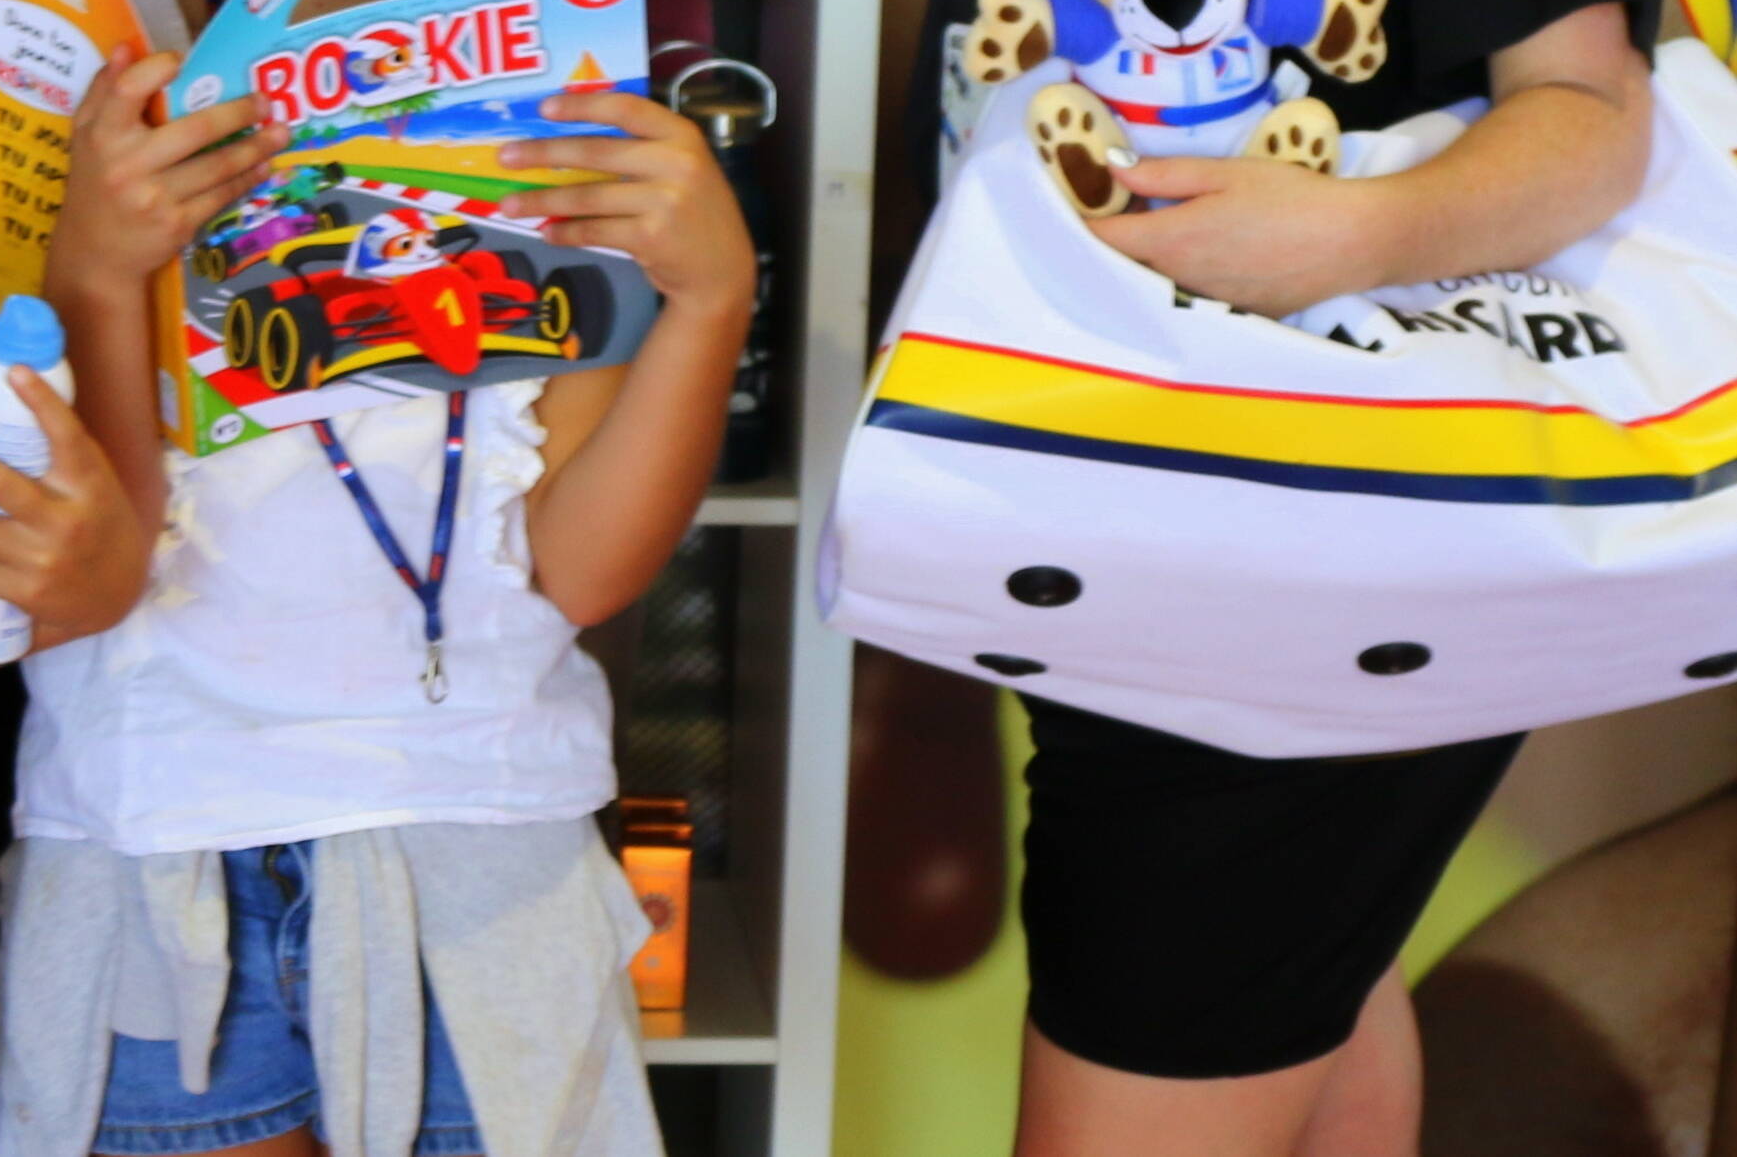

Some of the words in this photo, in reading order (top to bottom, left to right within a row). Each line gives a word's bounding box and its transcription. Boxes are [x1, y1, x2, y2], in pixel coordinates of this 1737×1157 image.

[0, 144, 28, 168] TU
[1, 180, 30, 205] TU
[3, 216, 32, 241] TU
[435, 288, 465, 327] 1
